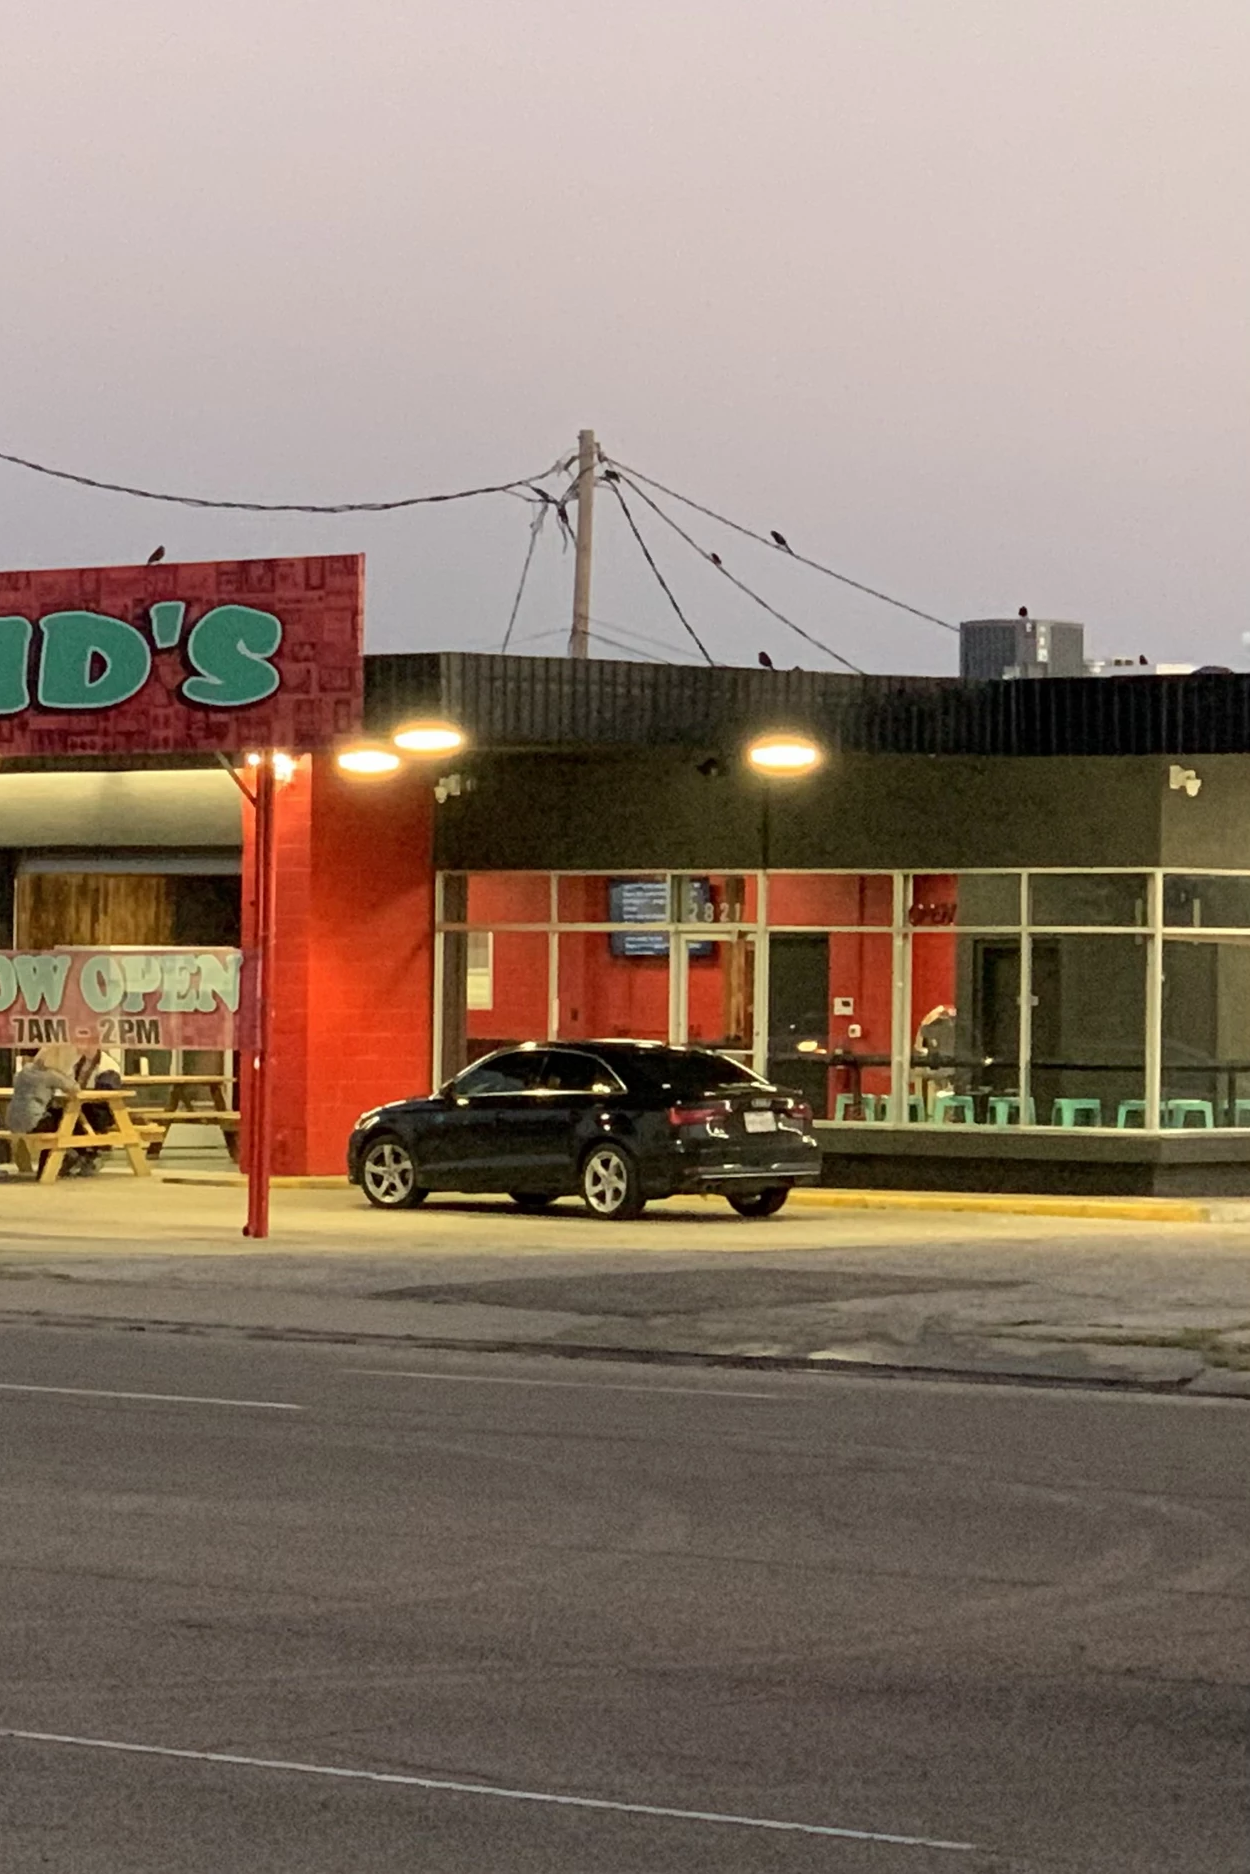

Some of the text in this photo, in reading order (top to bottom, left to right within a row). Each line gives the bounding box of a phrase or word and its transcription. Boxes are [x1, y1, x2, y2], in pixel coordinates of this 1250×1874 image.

[689, 903, 741, 923] 2821
[80, 954, 243, 1013] OPEN
[13, 1017, 69, 1043] 7AM
[99, 1017, 162, 1044] 2PM
